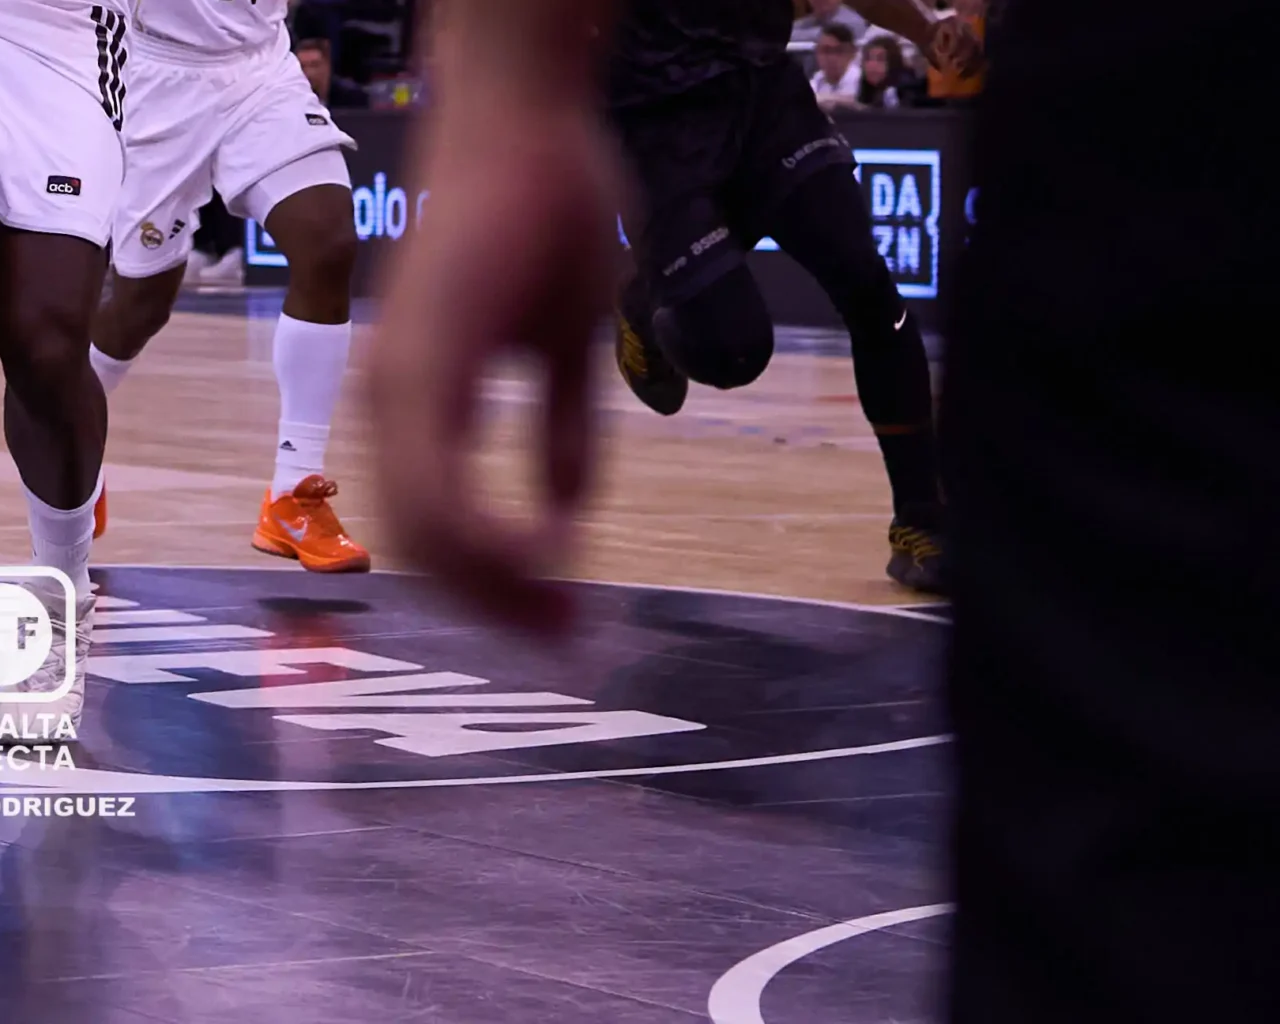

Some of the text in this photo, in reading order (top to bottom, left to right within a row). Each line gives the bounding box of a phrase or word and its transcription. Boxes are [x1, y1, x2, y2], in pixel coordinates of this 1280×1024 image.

[48, 181, 74, 194] acb
[353, 171, 407, 240] olo
[871, 174, 922, 218] DA
